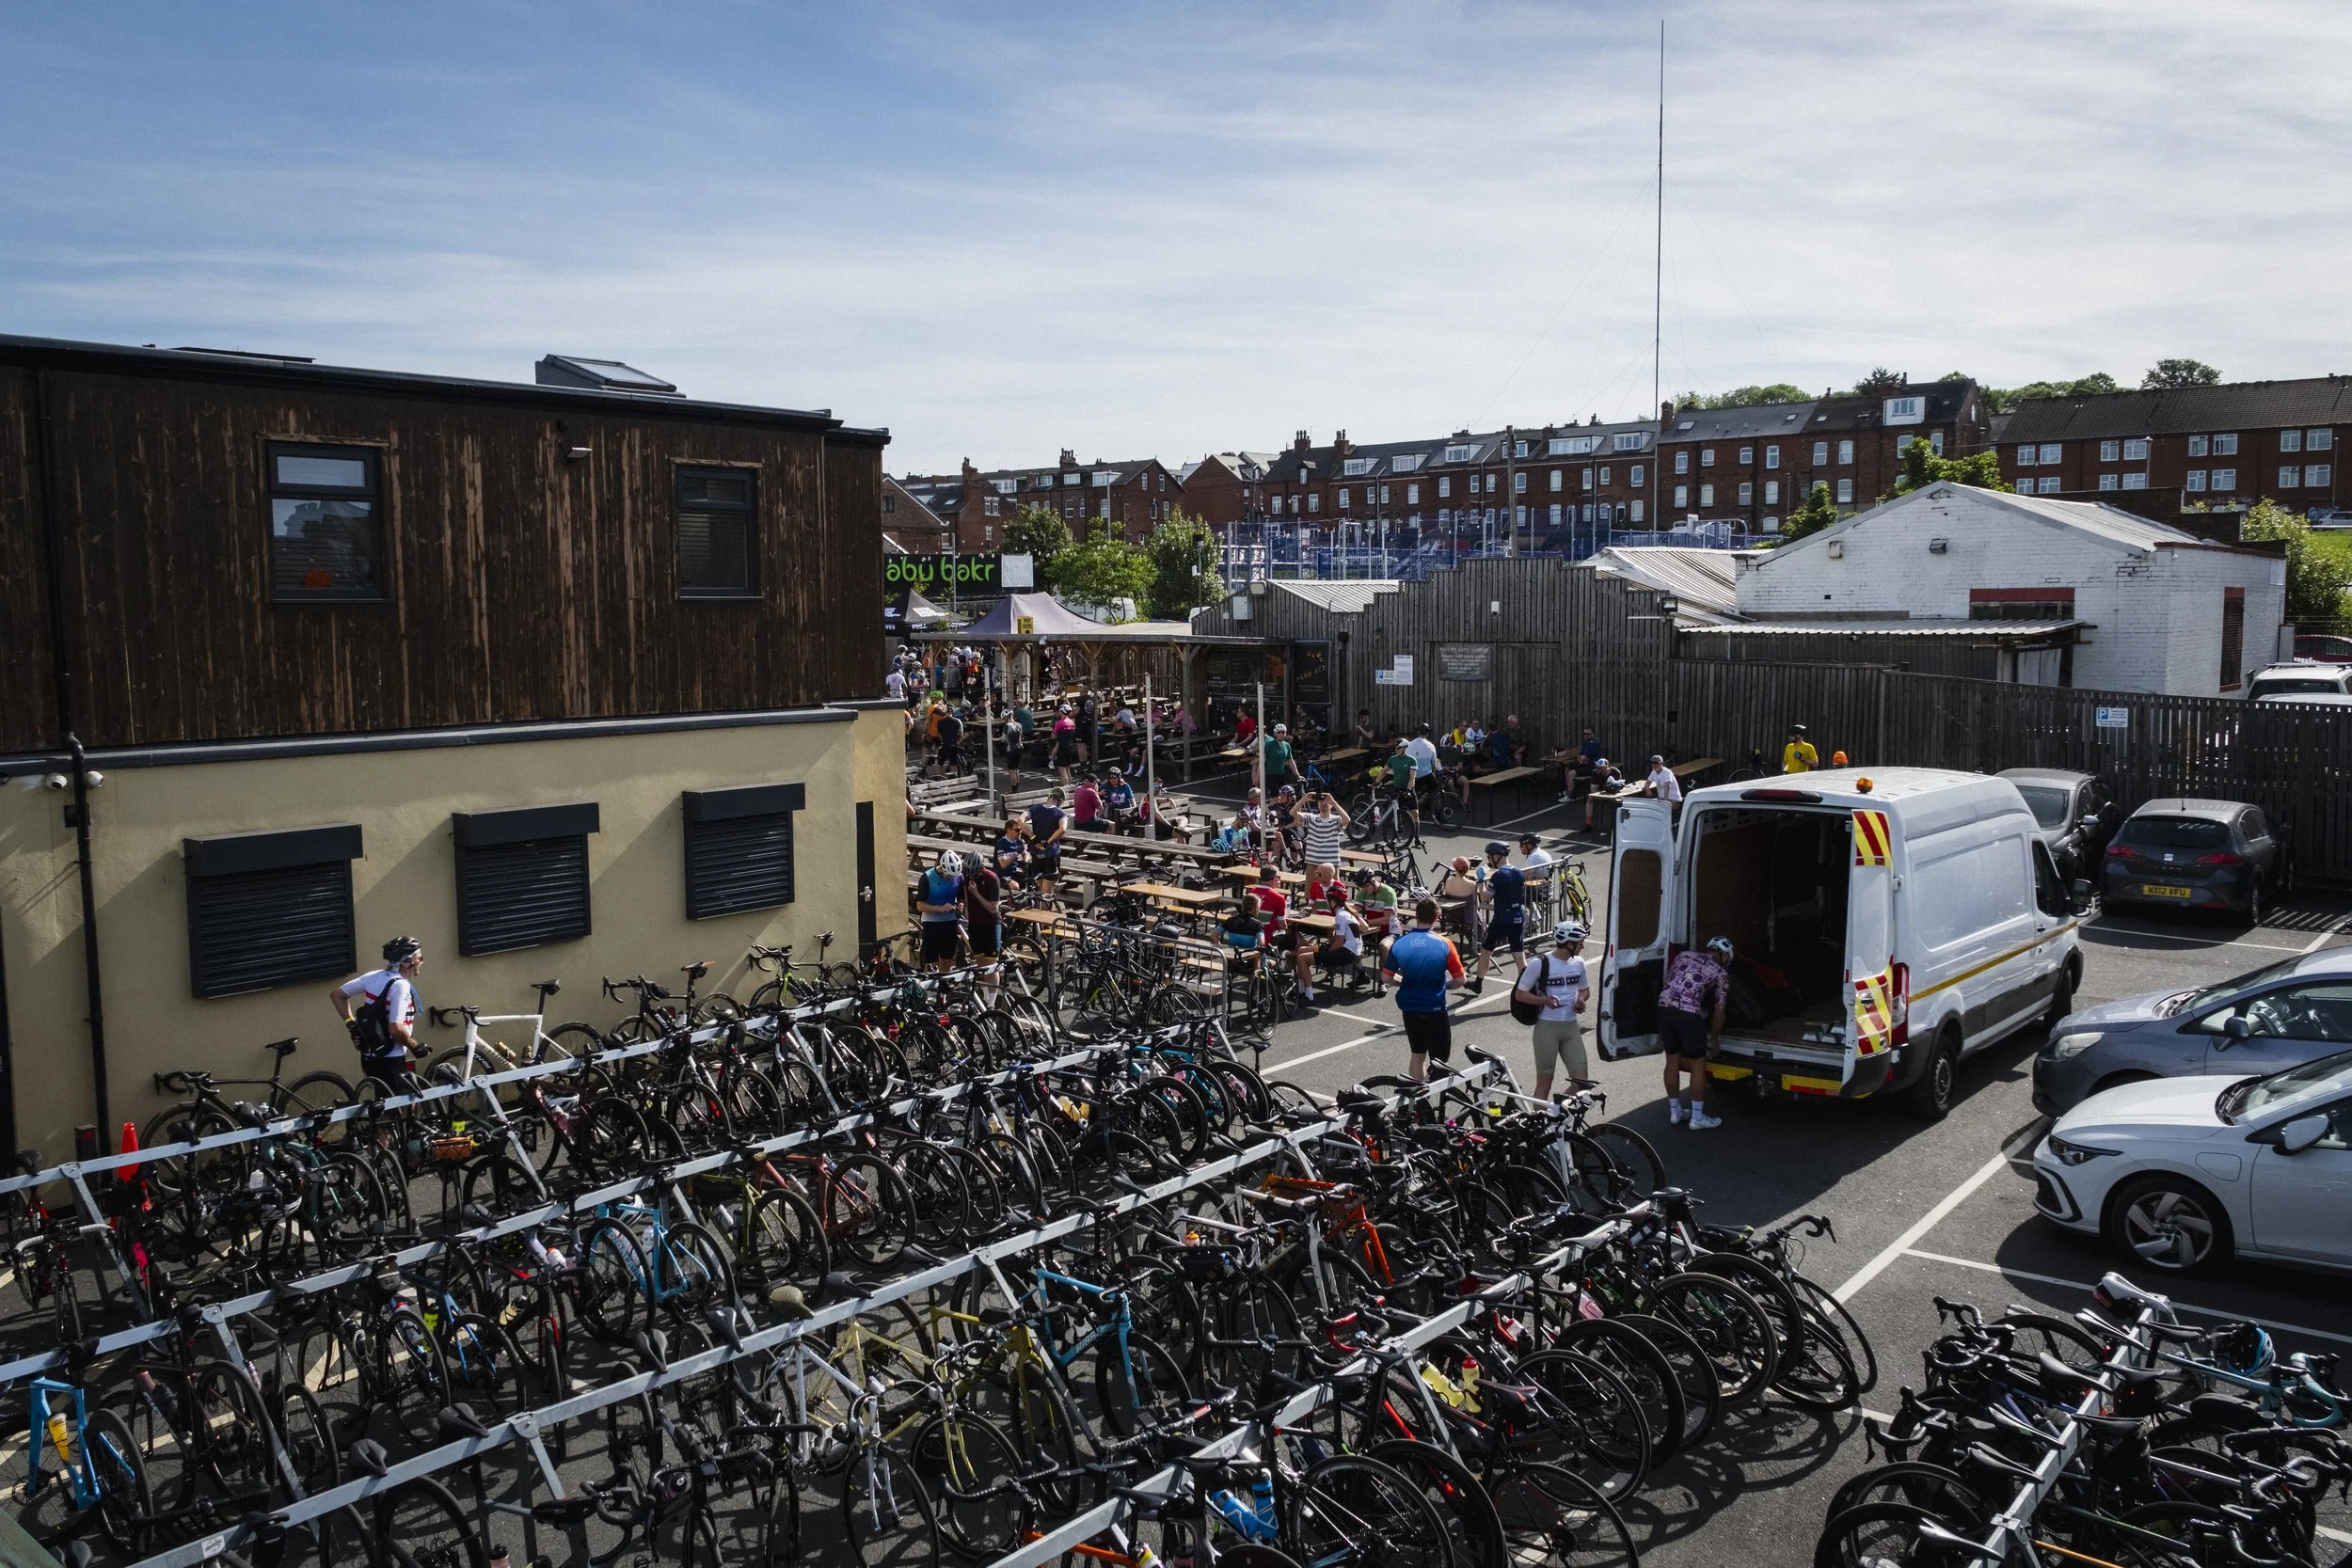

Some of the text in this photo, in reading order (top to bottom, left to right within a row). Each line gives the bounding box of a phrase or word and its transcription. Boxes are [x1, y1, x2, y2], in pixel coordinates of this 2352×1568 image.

[886, 557, 994, 582] abu bakr
[2099, 709, 2107, 719] P
[473, 1053, 491, 1069] oval
